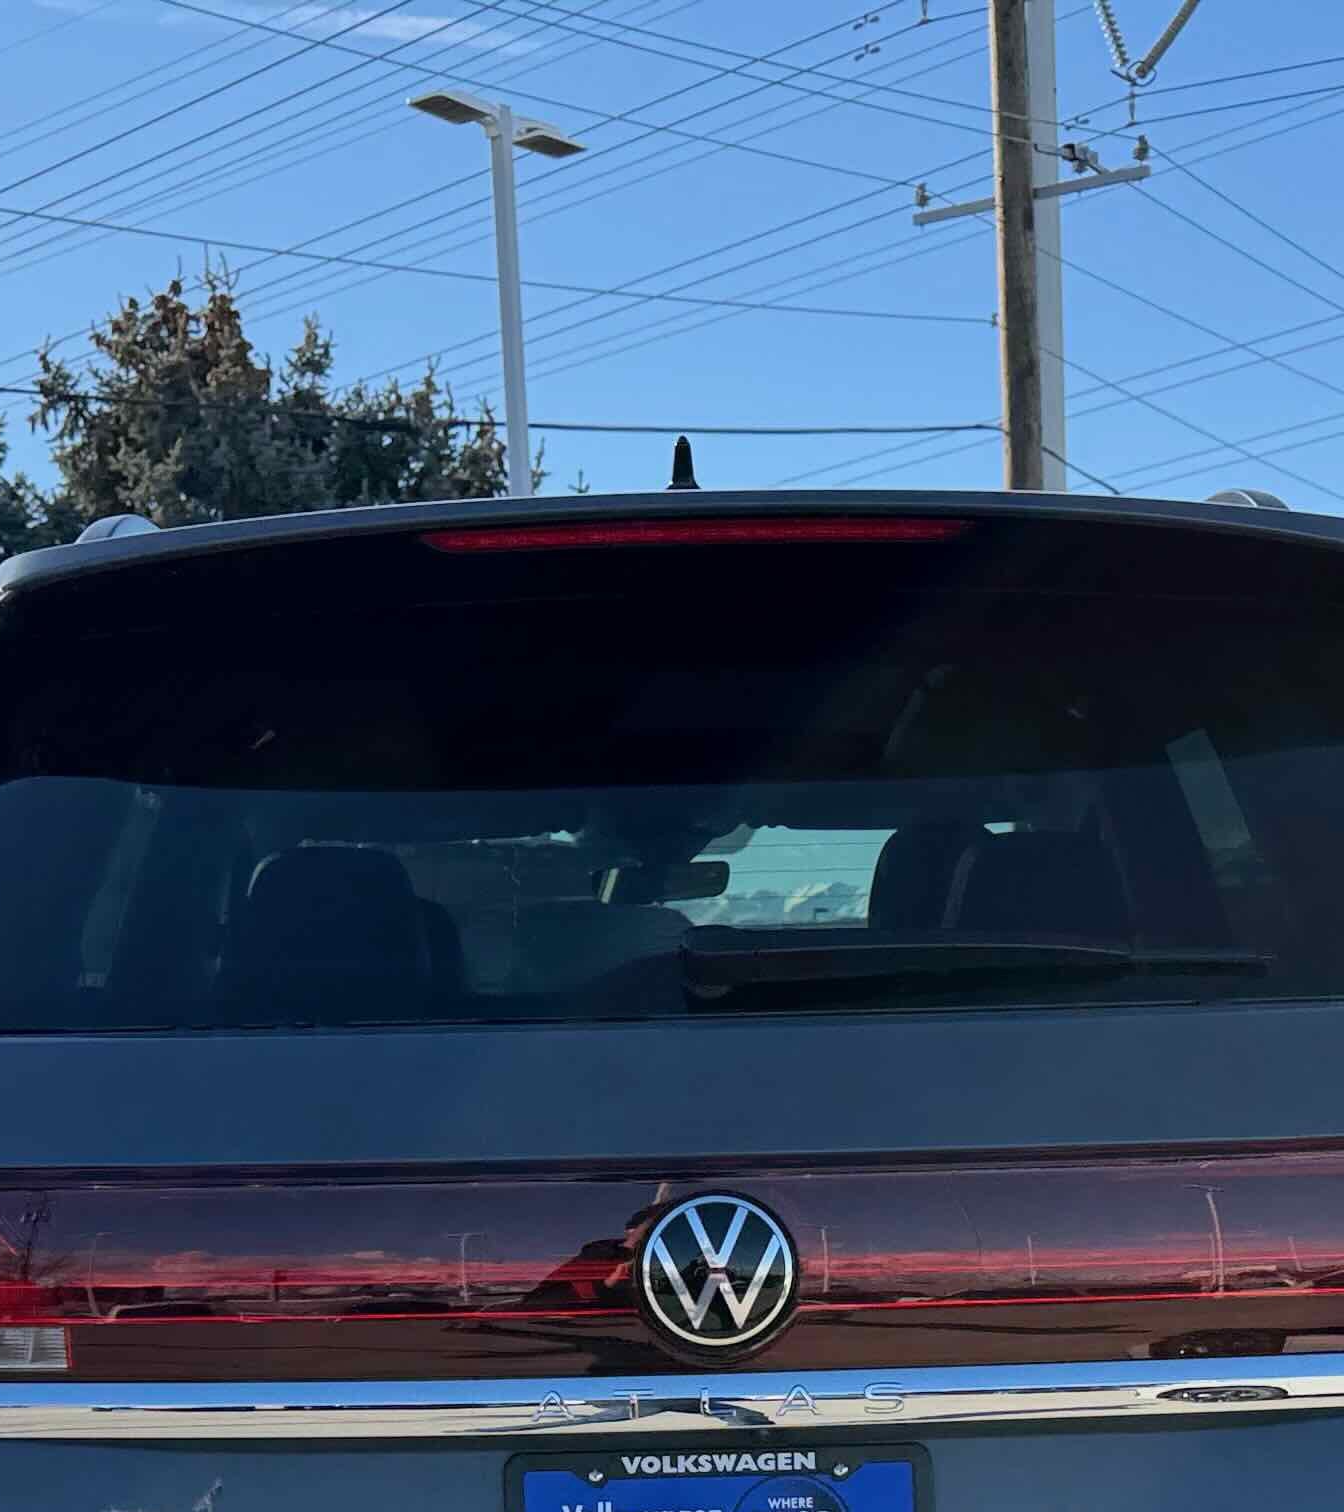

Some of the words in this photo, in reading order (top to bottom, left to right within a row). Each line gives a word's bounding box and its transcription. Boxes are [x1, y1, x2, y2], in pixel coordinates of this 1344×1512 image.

[650, 1203, 784, 1333] VW
[532, 1382, 905, 1421] ATLAS
[621, 1451, 816, 1474] VOLKSWAGEN
[767, 1496, 814, 1509] WHERE
